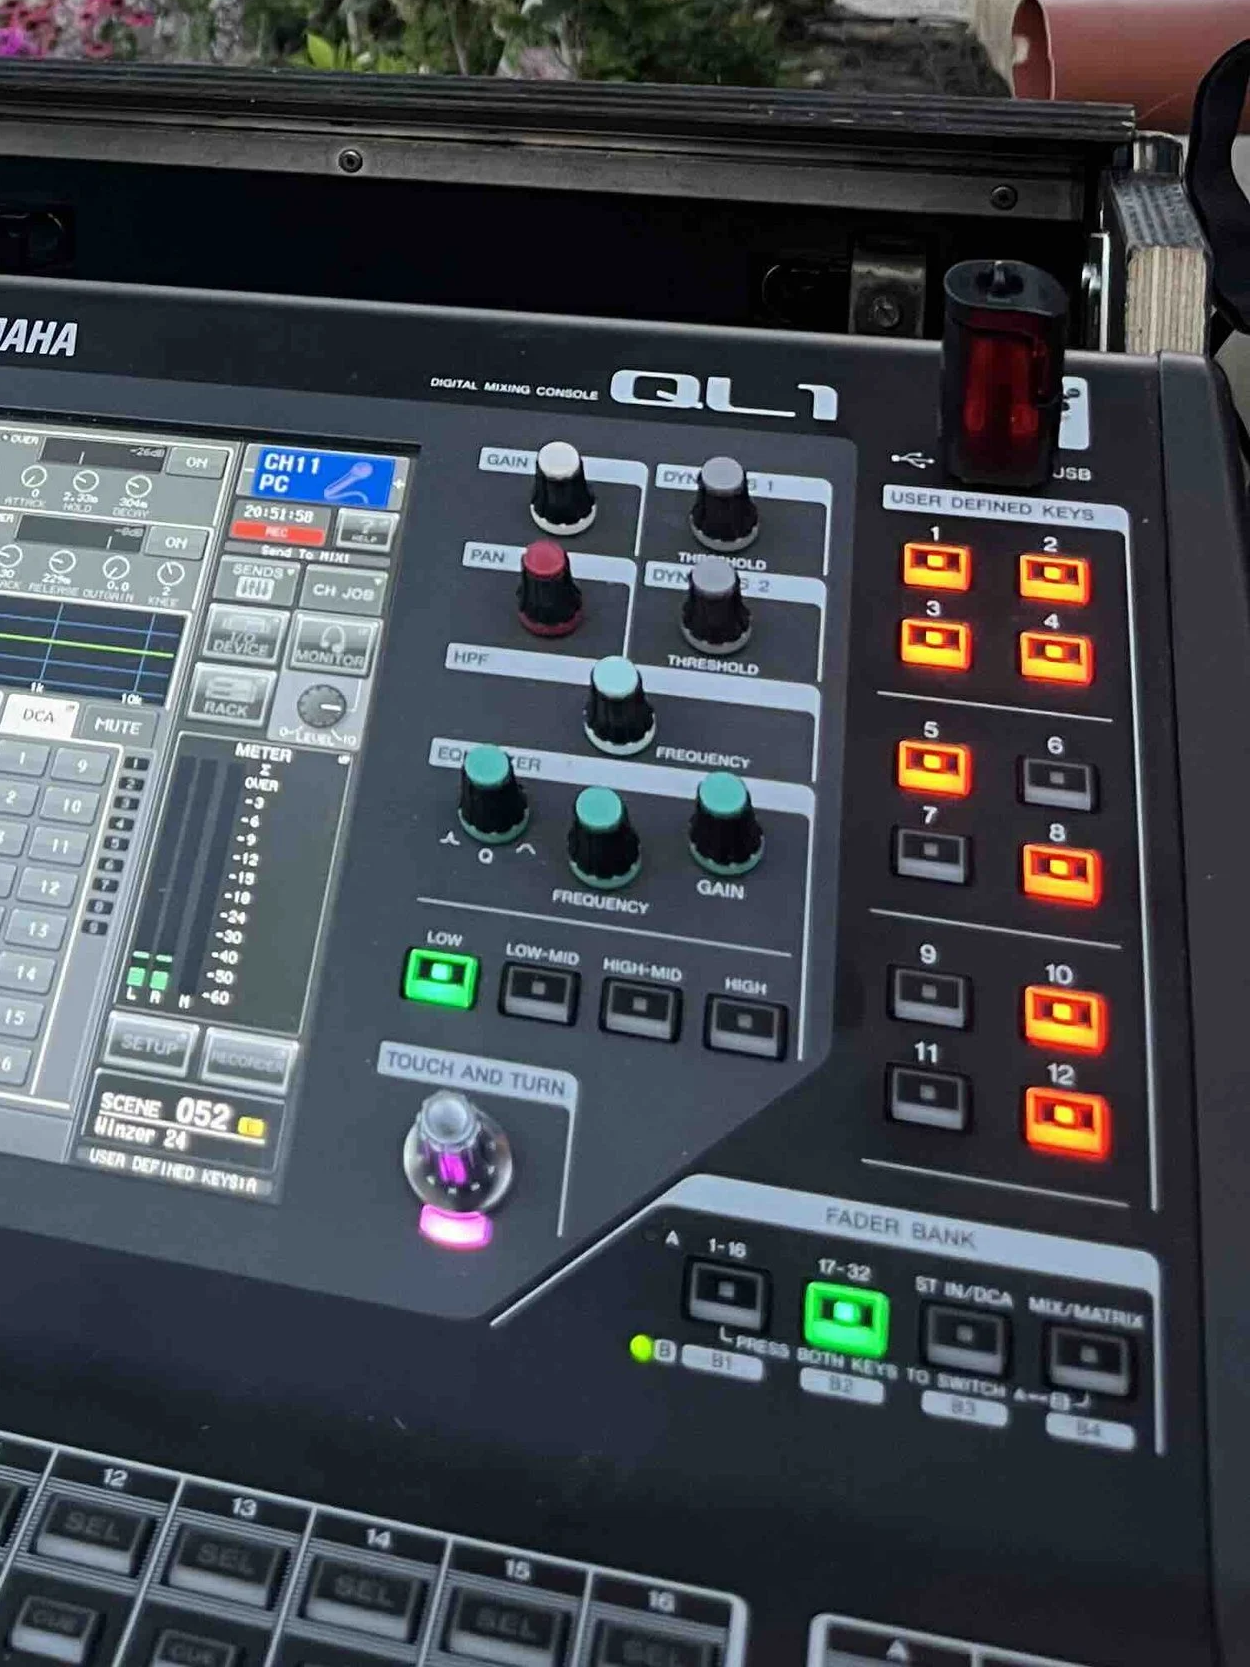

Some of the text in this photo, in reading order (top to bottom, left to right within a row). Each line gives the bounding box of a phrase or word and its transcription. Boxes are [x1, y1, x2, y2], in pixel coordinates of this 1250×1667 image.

[430, 377, 599, 400] DIGITAL MIXING CONSOLE
[610, 370, 838, 421] QL1
[264, 453, 319, 475] CH11
[487, 454, 528, 469] GAIN
[259, 474, 288, 493] PC
[767, 480, 774, 492] 1
[891, 491, 1094, 522] USER DEFINED KEYS
[930, 526, 941, 541] 1
[1043, 537, 1058, 552] 2
[470, 549, 505, 564] PAN
[233, 563, 283, 579] SENDS
[313, 584, 374, 602] CH JOB
[758, 580, 770, 593] 2
[926, 601, 941, 616] 3
[1044, 614, 1061, 630] 4
[454, 651, 489, 667] HPF
[668, 654, 759, 676] THRESHOLD
[23, 707, 55, 725] DCA
[203, 701, 248, 718] RACK
[95, 716, 142, 736] MUTE
[923, 721, 939, 738] 5
[235, 742, 292, 764] METER
[1047, 738, 1063, 755] 6
[656, 745, 751, 770] FREQUENCY
[923, 806, 938, 824] 7
[1049, 824, 1066, 842] 8
[478, 847, 494, 865] Q
[697, 879, 745, 900] GAIN
[552, 888, 650, 915] FREQUENCY
[427, 930, 463, 947] LOW
[506, 942, 580, 966] LOW-MID
[920, 945, 936, 965] 9
[603, 957, 683, 983] HIGH-MID
[1044, 964, 1074, 985] 10
[725, 977, 768, 996] HIGH
[913, 1041, 939, 1063] 11
[387, 1050, 566, 1096] TOUCH AND TURN
[1047, 1064, 1076, 1086] 12
[100, 1092, 232, 1132] SCENE 052
[163, 1129, 188, 1151] 24
[89, 1147, 126, 1169] USER
[132, 1154, 195, 1181] DEFINED
[665, 1229, 679, 1246] A
[826, 1206, 976, 1249] FADER BANK
[708, 1238, 747, 1260] 1-16
[818, 1258, 872, 1281] 17-32
[915, 1275, 1013, 1308] ST IN/DCA
[1029, 1296, 1144, 1329] MIX/MATRIX
[712, 1354, 734, 1371] B1
[736, 1335, 1006, 1399] PRESS BOTH KEYS TO SWITCH
[104, 1468, 128, 1488] 12
[232, 1496, 257, 1518] 13
[366, 1528, 392, 1550] 14
[504, 1558, 531, 1581] 15
[647, 1589, 676, 1611] 16
